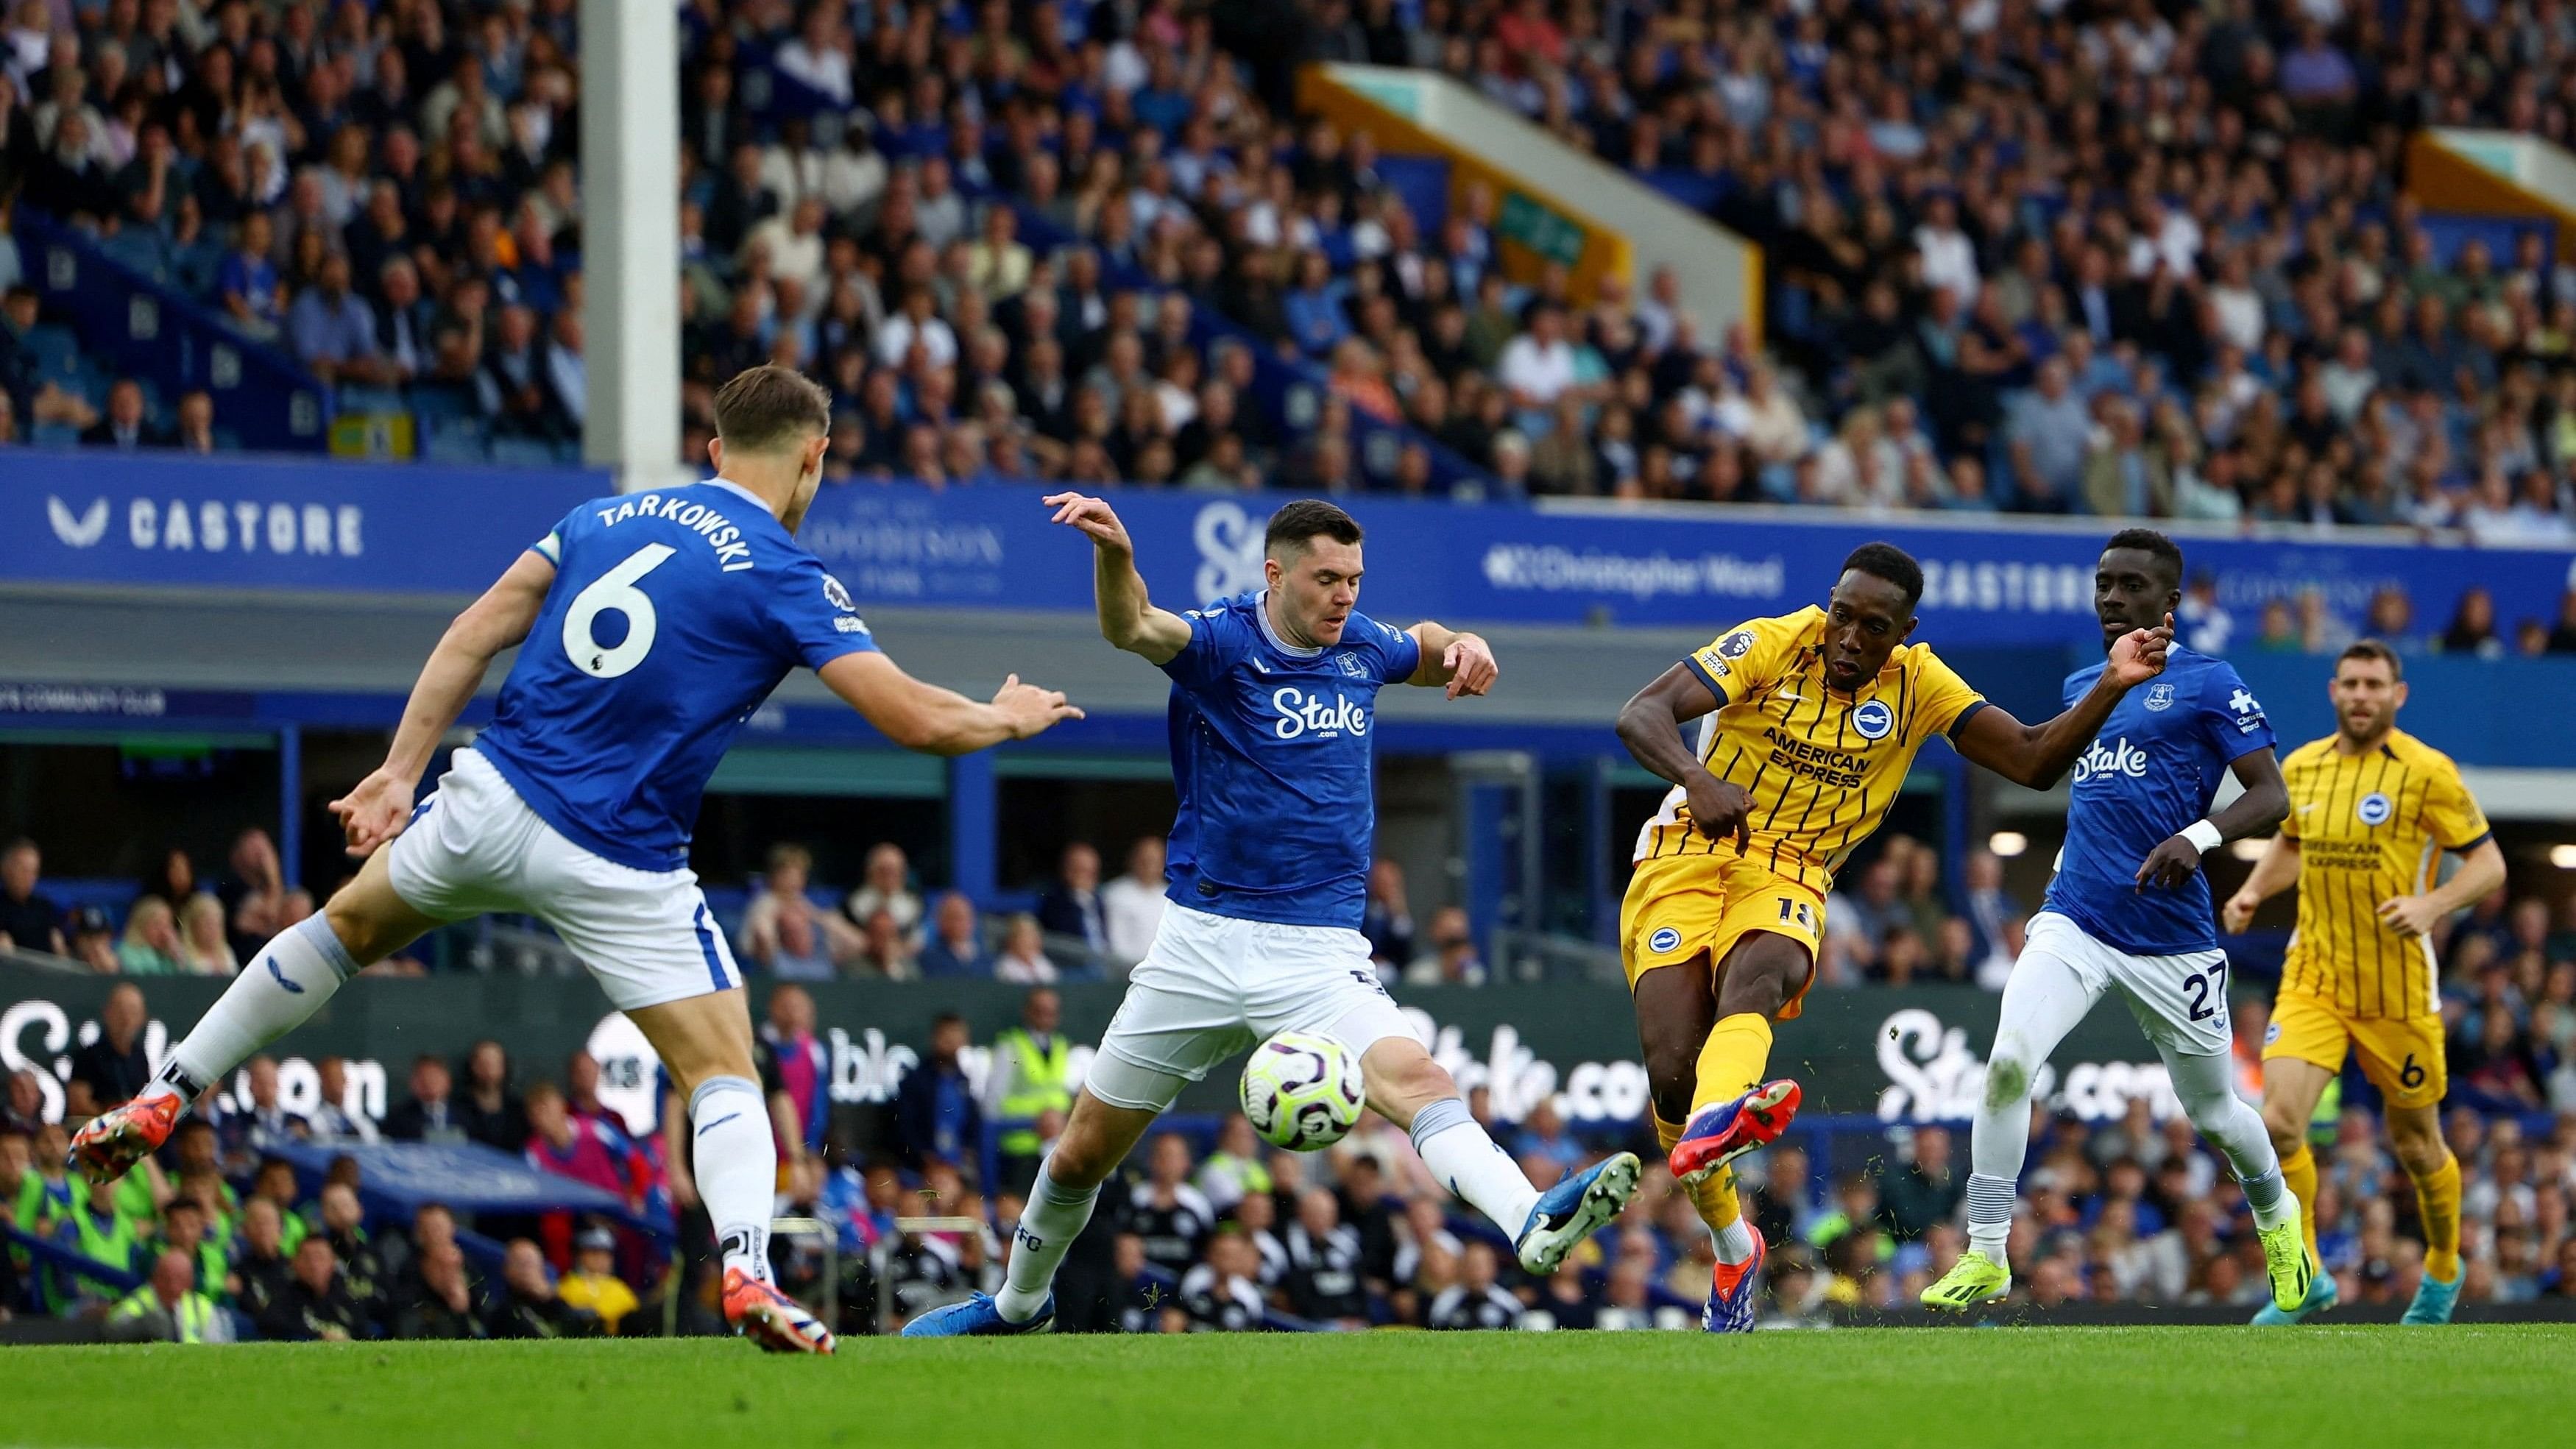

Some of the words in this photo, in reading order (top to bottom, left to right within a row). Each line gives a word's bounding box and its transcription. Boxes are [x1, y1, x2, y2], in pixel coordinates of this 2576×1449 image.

[129, 496, 364, 557] CASTORE
[597, 494, 754, 573] TARKOWSKI
[562, 542, 677, 679] 6
[1920, 558, 2097, 615] CASTOR
[1273, 687, 1366, 739] Stake
[2237, 712, 2266, 726] Christo
[2240, 720, 2260, 734] Ward
[1762, 726, 1872, 773] AMERICAN
[1769, 748, 1864, 789] EXPRESS
[2183, 959, 2226, 1021] 27
[2401, 1052, 2426, 1088] 6
